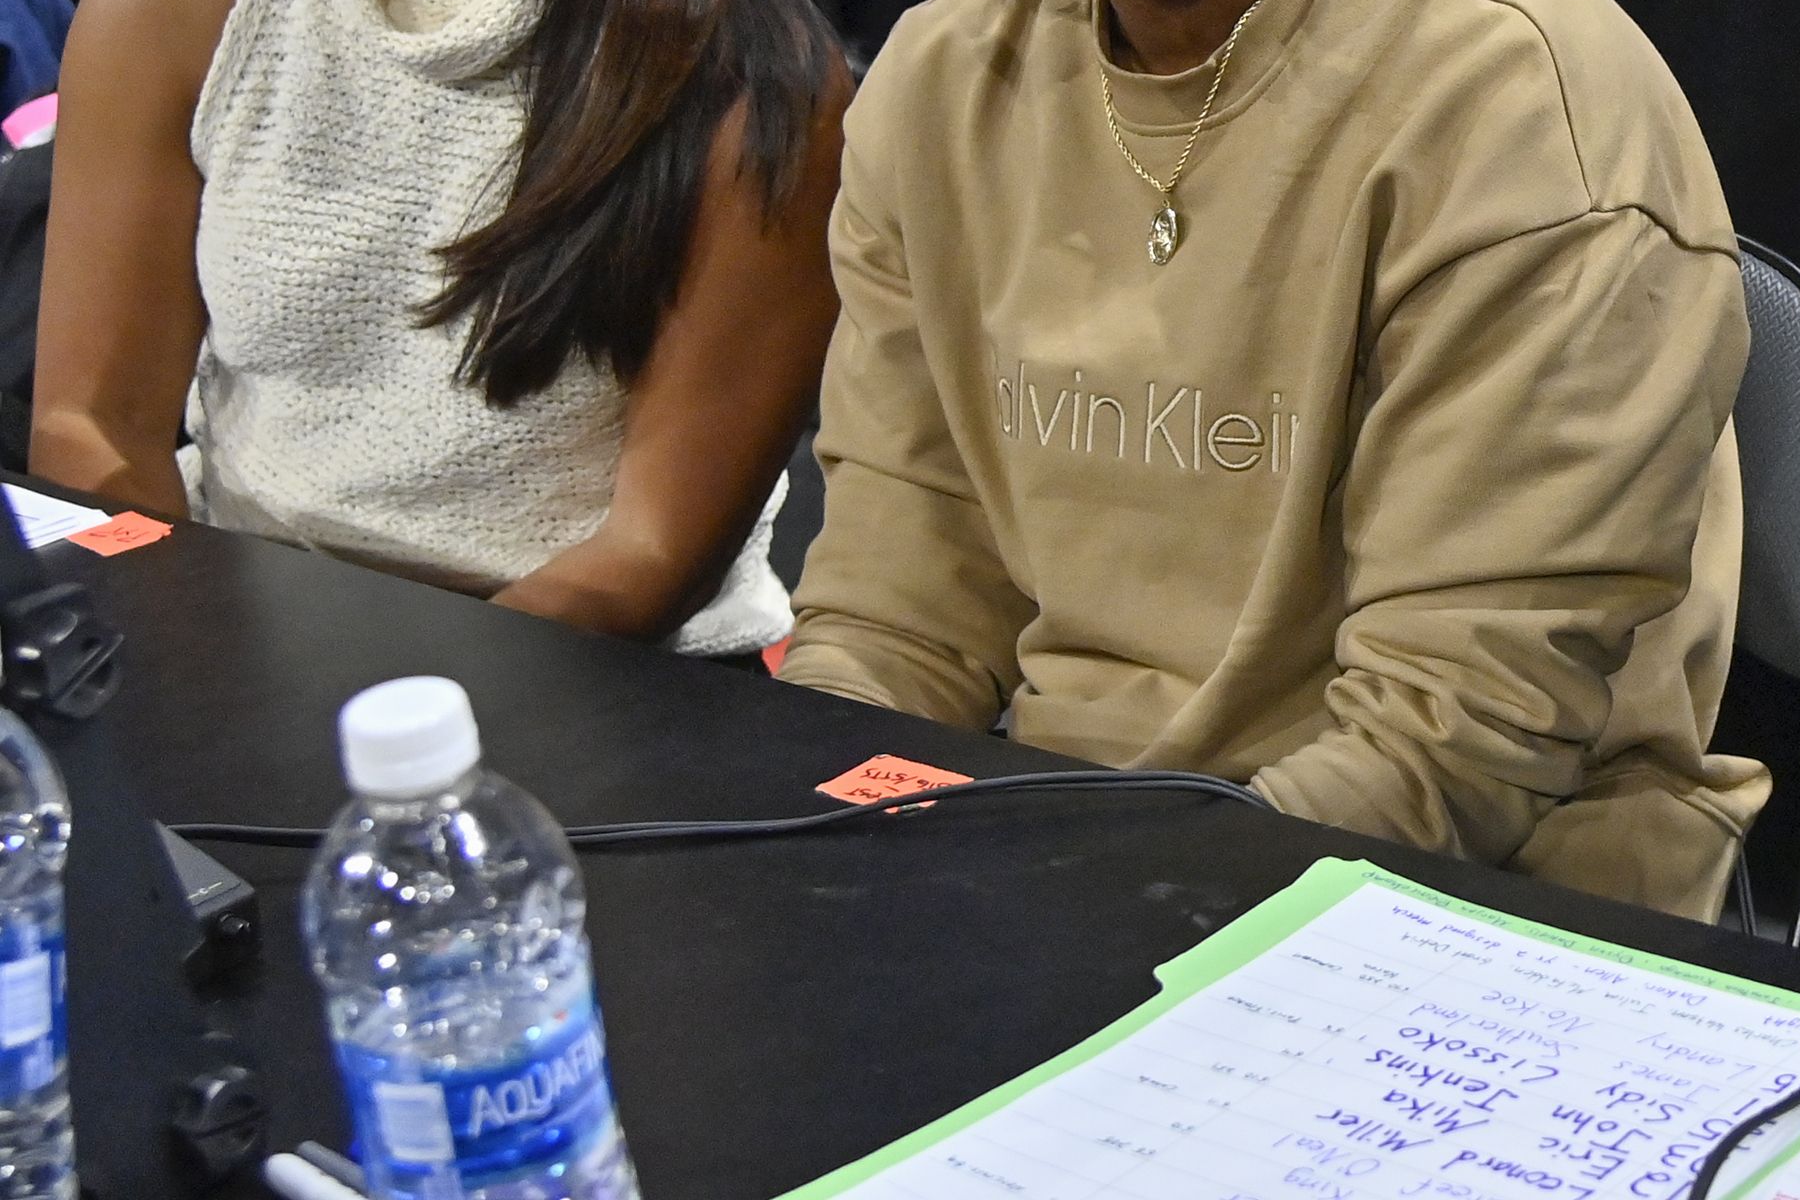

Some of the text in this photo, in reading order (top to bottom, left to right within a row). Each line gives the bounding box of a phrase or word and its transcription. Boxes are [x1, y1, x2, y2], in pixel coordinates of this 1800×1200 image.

[998, 361, 1124, 458] alvin
[1636, 1031, 1756, 1080] Landry
[1365, 1050, 1518, 1112] Jenkins
[1595, 1081, 1684, 1122] Sidy
[1612, 1060, 1720, 1104] James
[1316, 1110, 1434, 1152] Miller
[1383, 1090, 1490, 1134] Mika
[1552, 1105, 1652, 1155] John
[1539, 1137, 1625, 1180] Eric
